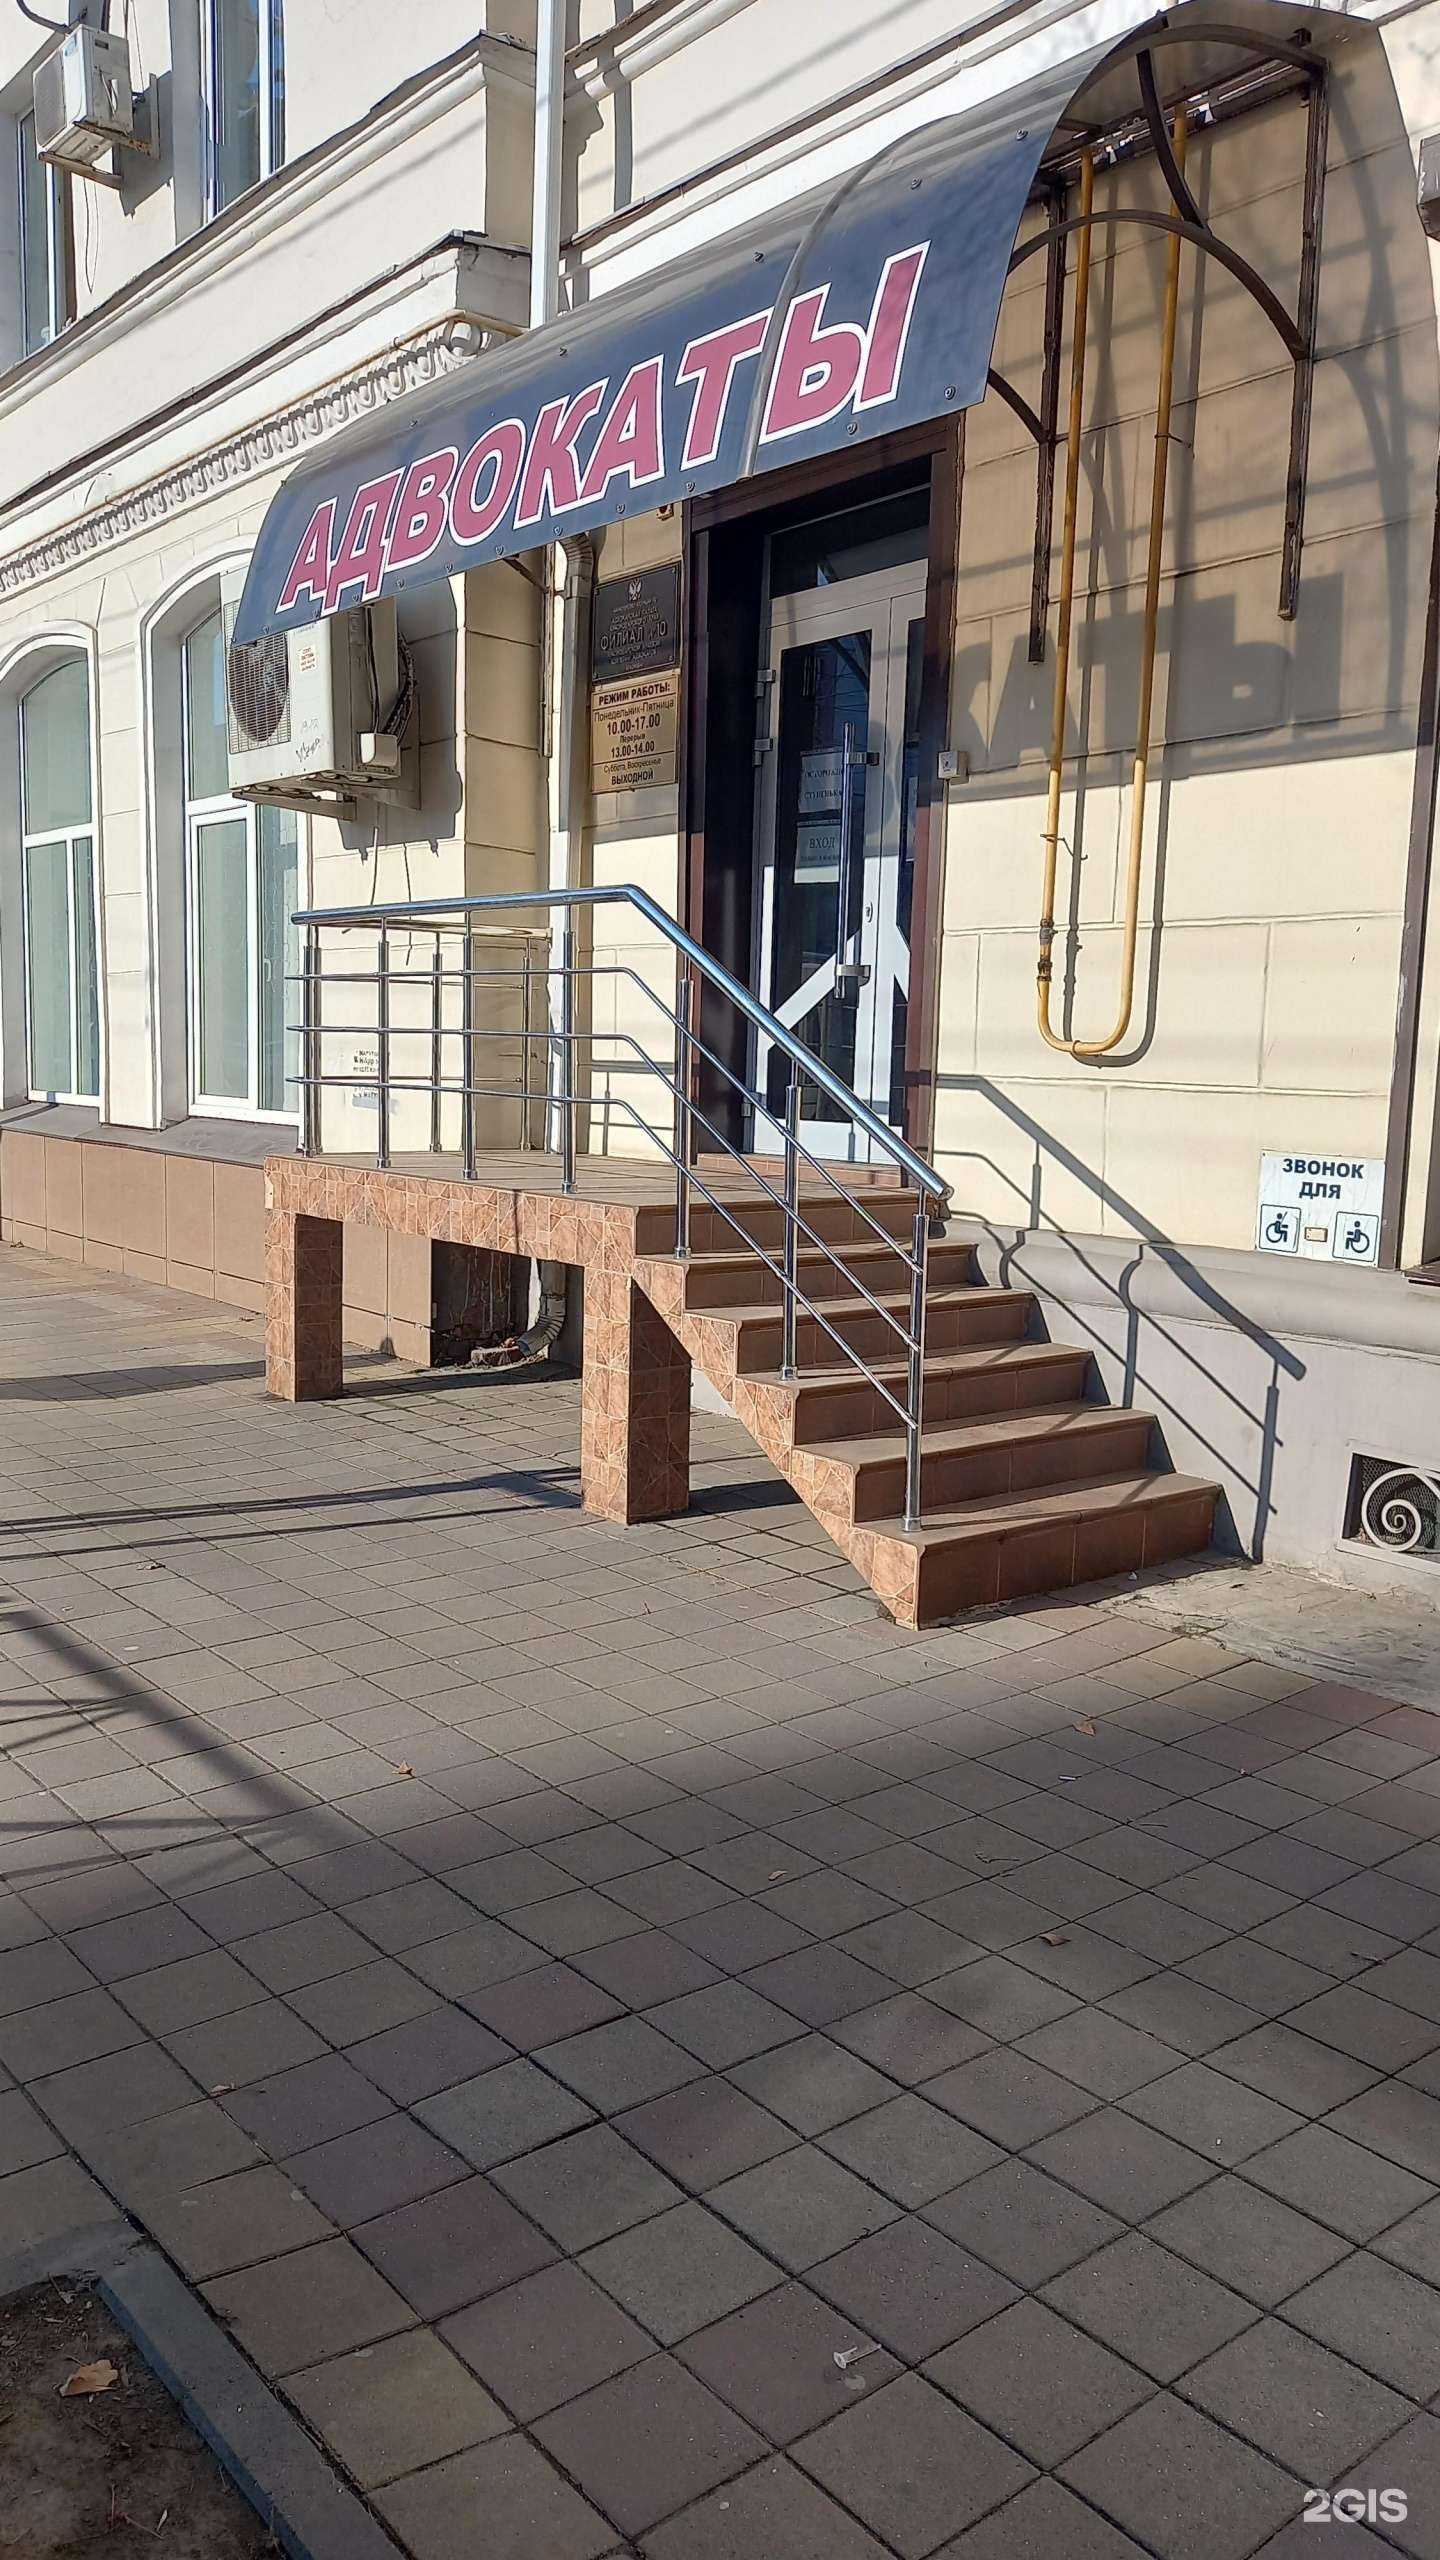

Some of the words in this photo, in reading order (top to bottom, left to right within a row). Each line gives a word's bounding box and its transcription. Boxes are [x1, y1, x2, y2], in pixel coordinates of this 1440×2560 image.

[276, 241, 931, 616] АДВОКАТЫ
[600, 626, 644, 650] ФИЛИАЛ
[598, 689, 629, 706] РЕЖИМ
[631, 682, 671, 699] РАБОТЫ:
[594, 699, 674, 722] Понедельник-Пятница
[607, 712, 661, 736] 10.00-17.00
[620, 733, 646, 744] Перерыв
[611, 740, 655, 759] 13.00-14.00
[611, 767, 654, 786] ВЫХОДНОЙ
[809, 837, 836, 849] ВХОД
[1282, 1158, 1365, 1179] ЗВОНОК
[1299, 1181, 1342, 1199] ДЛЯ
